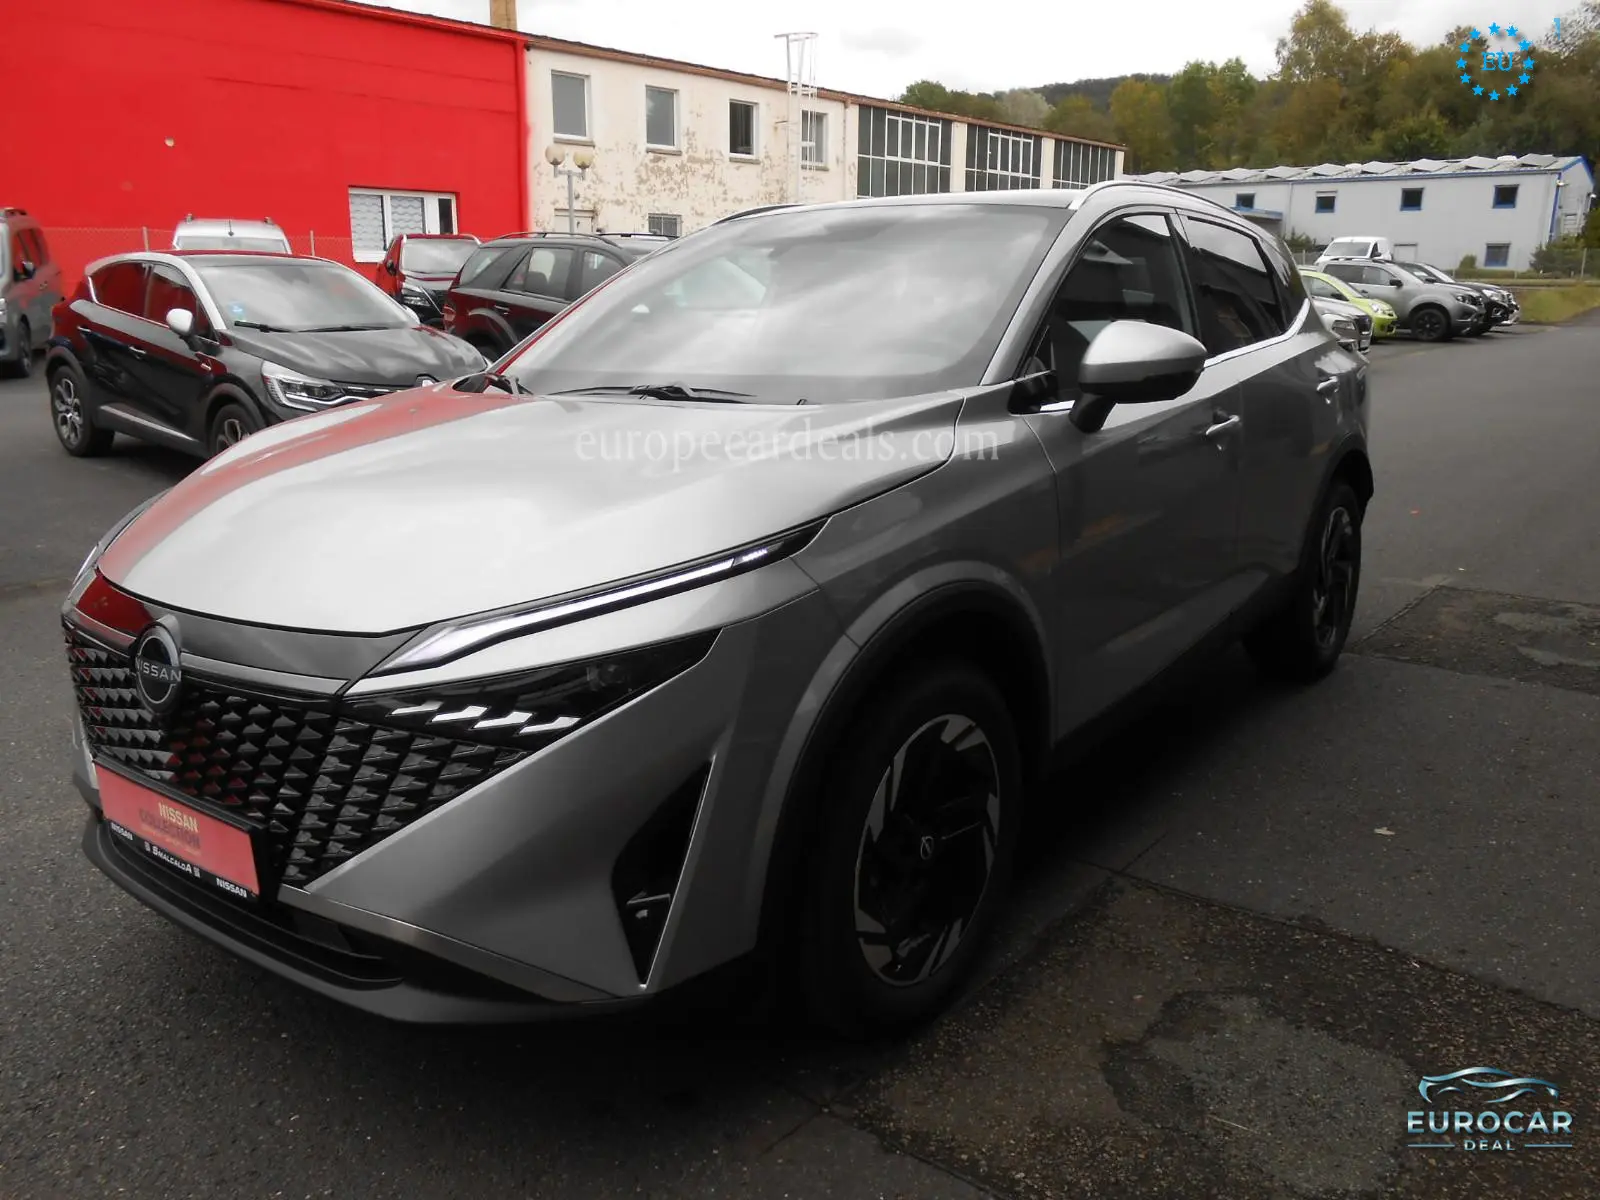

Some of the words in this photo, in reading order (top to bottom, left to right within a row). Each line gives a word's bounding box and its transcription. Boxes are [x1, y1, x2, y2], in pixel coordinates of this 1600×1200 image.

[135, 656, 182, 682] NISSAN
[158, 801, 199, 833] NISSAN
[216, 877, 248, 899] NISSAN
